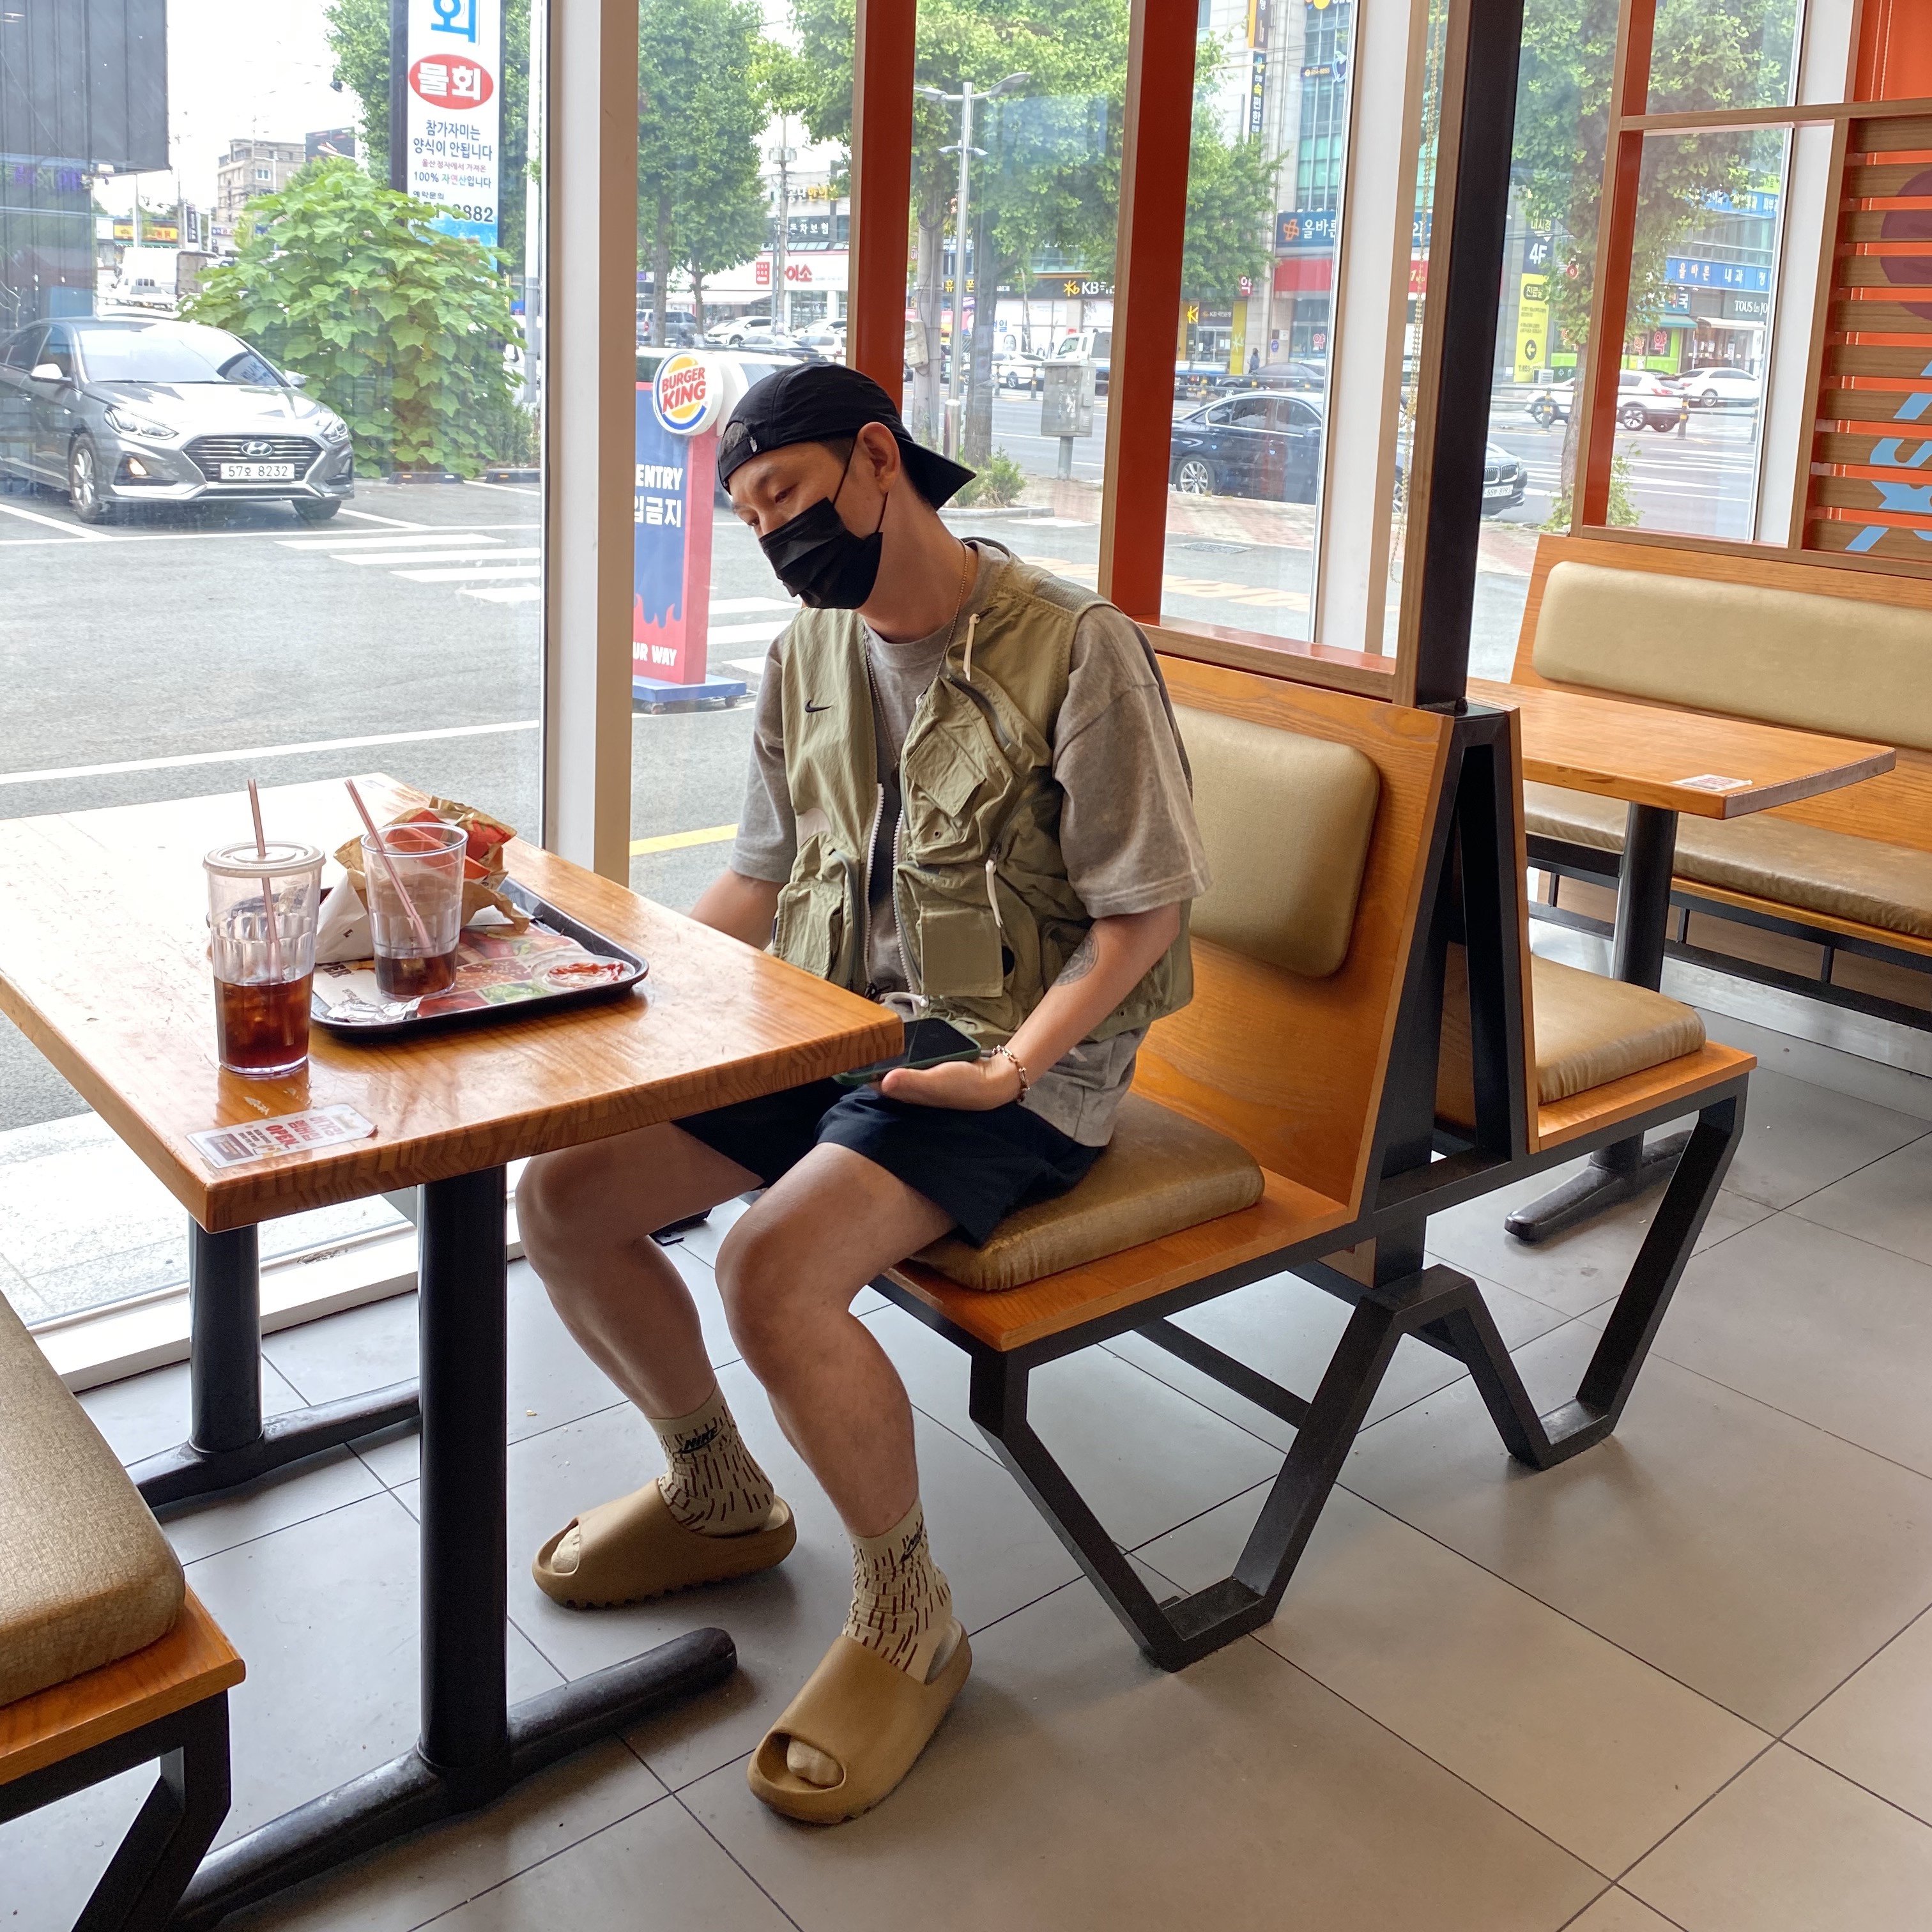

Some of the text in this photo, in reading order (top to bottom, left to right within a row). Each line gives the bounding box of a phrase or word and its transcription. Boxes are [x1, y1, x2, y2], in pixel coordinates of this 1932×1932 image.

[418, 61, 482, 101] 물회
[426, 119, 480, 141] 참가자미는
[413, 137, 493, 161] 양식이 안됩니다
[414, 171, 491, 188] 100% 자연산입니다
[1529, 243, 1547, 264] 4F
[1724, 268, 1744, 284] 내과
[1735, 300, 1753, 312] TOUS
[1654, 331, 1667, 355] 약
[662, 367, 705, 394] BURGER
[663, 380, 707, 413] KING
[229, 465, 288, 477] 57호 8232
[636, 464, 684, 491] ENTRY
[651, 644, 677, 666] WAY
[265, 1124, 300, 1146] OPEN
